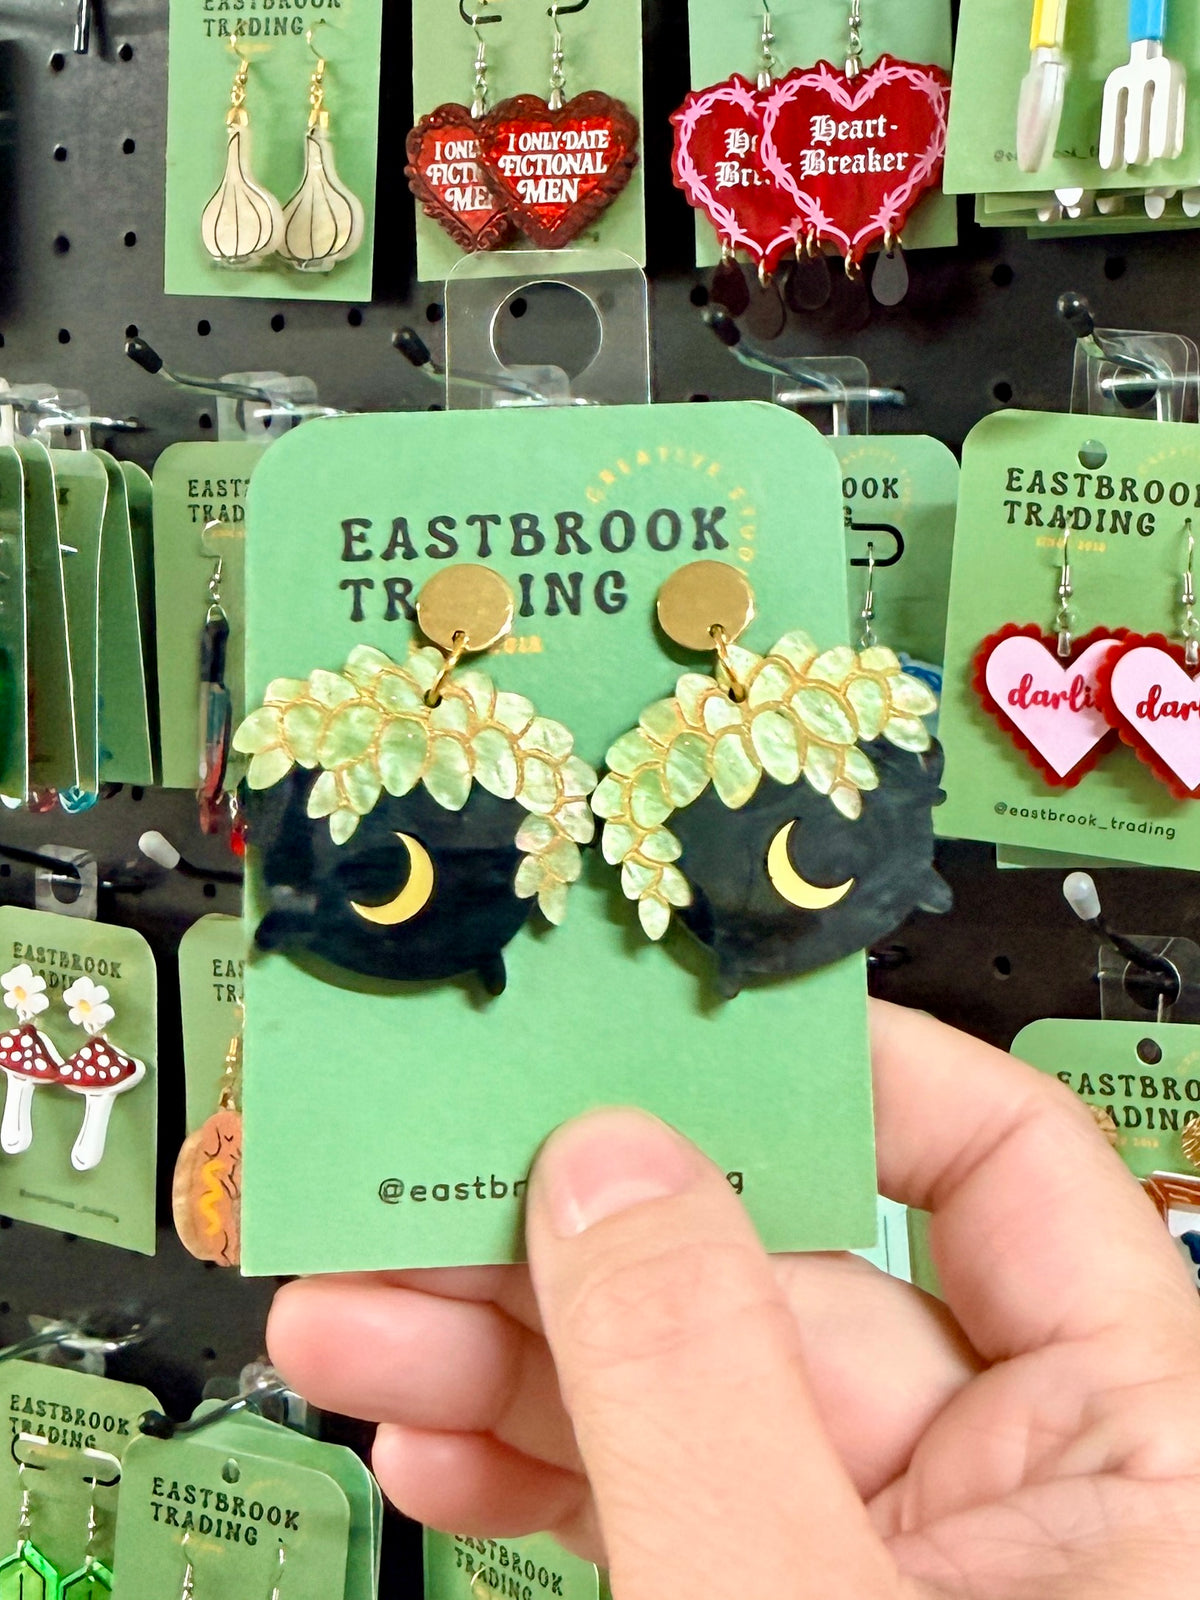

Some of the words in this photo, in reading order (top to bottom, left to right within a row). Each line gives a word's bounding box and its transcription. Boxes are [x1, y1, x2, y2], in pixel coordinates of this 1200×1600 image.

[203, 16, 304, 37] TRADING
[508, 133, 516, 152] I
[518, 131, 564, 151] ONLY
[562, 129, 609, 149] DATE
[809, 114, 898, 146] Heart-
[434, 141, 442, 160] I
[497, 152, 608, 177] FICTIONAL
[799, 147, 909, 180] Breaker
[444, 186, 493, 211] ME
[516, 178, 580, 204] MEN
[187, 503, 245, 523] TRAD
[1003, 500, 1156, 537] TRADING
[340, 506, 730, 562] EASTBROOK
[340, 570, 628, 622] TRING
[1008, 673, 1102, 713] darli
[1136, 684, 1200, 722] dar
[994, 801, 1177, 840] @eastbrook_trading
[13, 941, 122, 979] EASTBROOK
[9, 1416, 97, 1449] TRADING
[10, 1394, 130, 1436] EASTBROOK
[152, 1477, 300, 1530] EASTBROOK
[150, 1502, 258, 1546] TRADING
